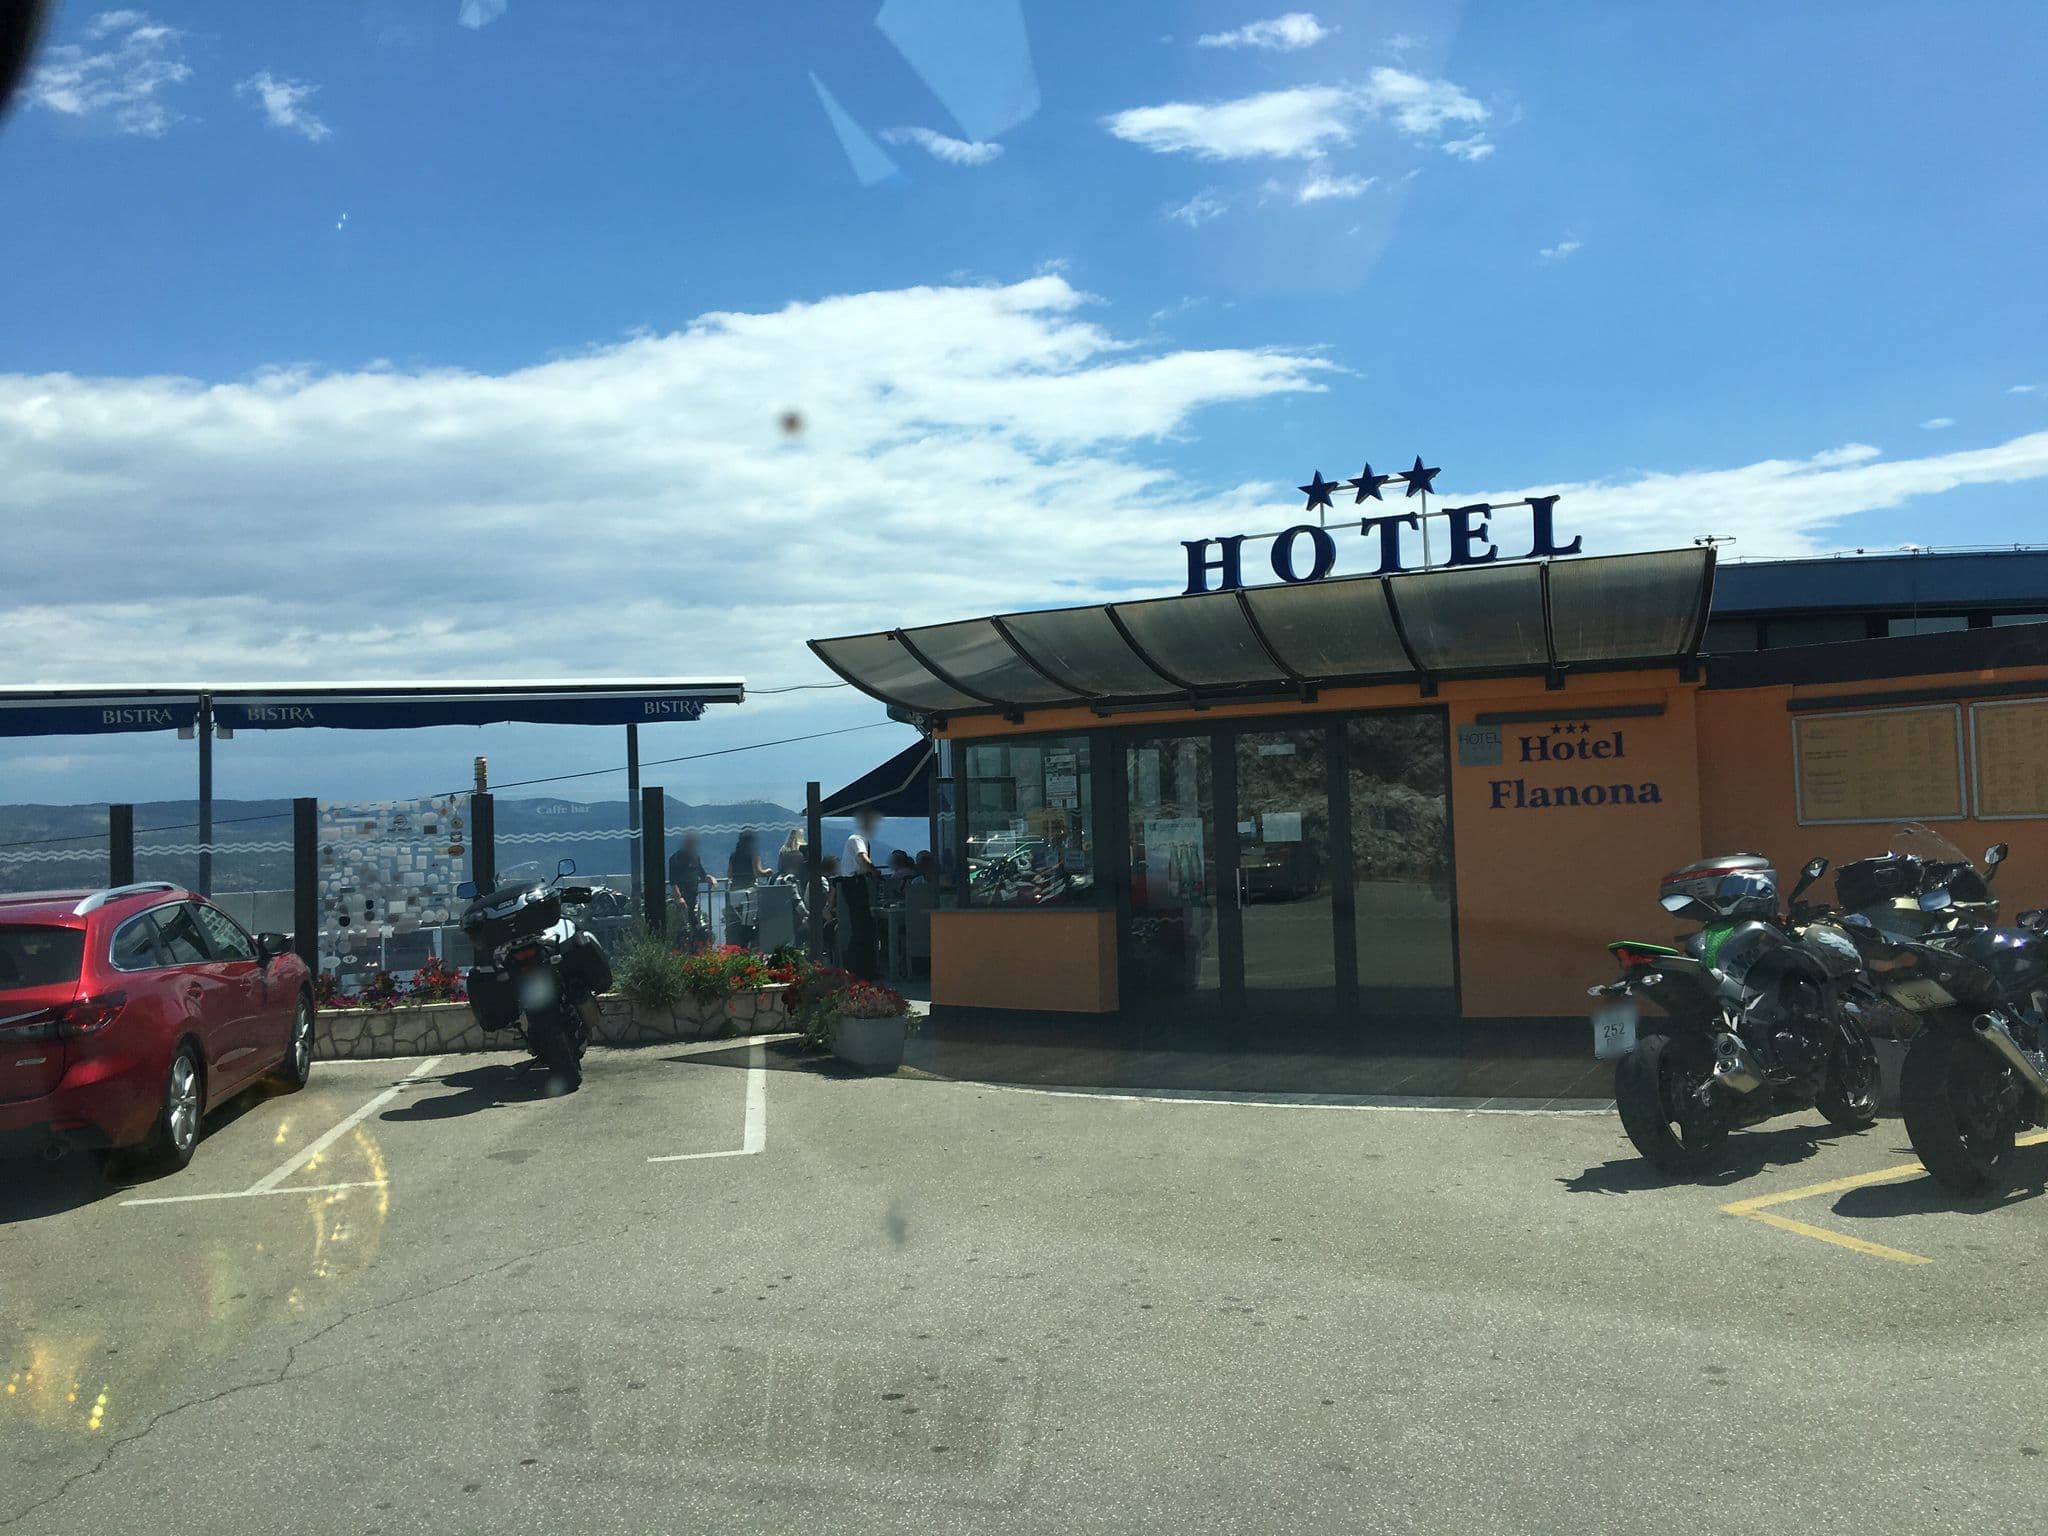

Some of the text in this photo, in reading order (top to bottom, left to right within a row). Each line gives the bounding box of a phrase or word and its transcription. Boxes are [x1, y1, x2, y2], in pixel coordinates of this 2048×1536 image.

[1181, 495, 1582, 595] HOTEL
[102, 709, 173, 725] BISTRA
[247, 706, 314, 723] BISTRA
[644, 701, 702, 716] BISTRA
[1459, 732, 1502, 744] HOTEL
[1518, 731, 1625, 763] Hotel
[1488, 779, 1663, 809] Flanona
